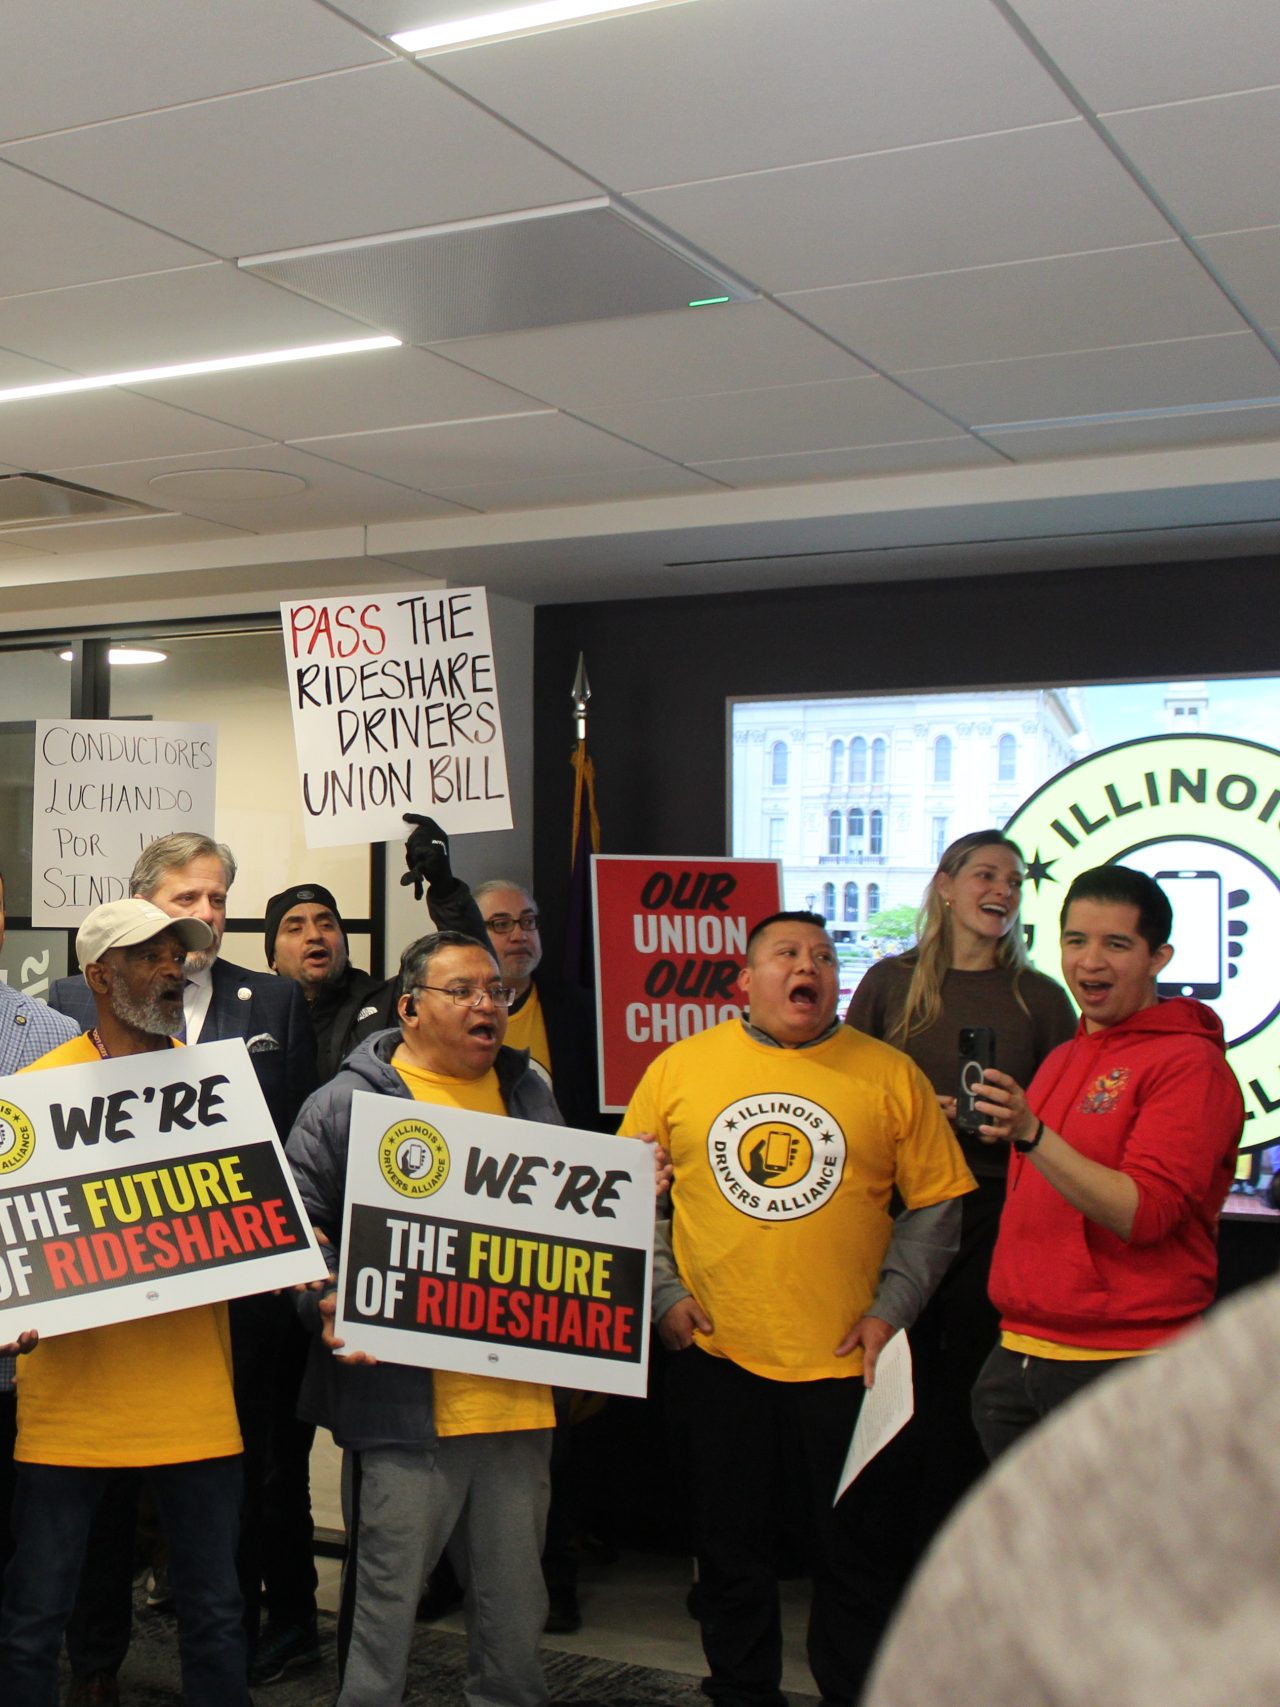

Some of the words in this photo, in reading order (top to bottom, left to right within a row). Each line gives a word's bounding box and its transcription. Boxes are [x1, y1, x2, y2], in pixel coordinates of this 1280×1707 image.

[290, 603, 386, 658] PASS
[397, 593, 474, 645] THE
[296, 652, 493, 709] RIDESHARE
[42, 727, 213, 769] CONDUCTORES
[337, 701, 496, 756] DRIVERS
[44, 779, 193, 815] LUCHANDO
[303, 758, 412, 816] UNION
[429, 754, 505, 804] BILL
[1050, 768, 1280, 848] ILLINOI
[640, 871, 737, 911] OUR
[633, 914, 747, 955] UNION
[644, 958, 741, 999] OUR
[49, 1074, 230, 1150] WE'RE
[394, 1125, 438, 1144] ILLINOIS
[738, 1102, 824, 1129] ILLINOIS
[2, 1125, 30, 1169] ALLIANCE
[384, 1149, 408, 1191] DRIVERS
[411, 1158, 446, 1193] ALLIANCE
[82, 1155, 253, 1229] FUTURE
[463, 1146, 632, 1220] WE'RE
[714, 1140, 761, 1208] DRIVERS
[766, 1155, 837, 1212] ALLIANCE
[42, 1199, 297, 1291] RIDESHARE
[385, 1218, 459, 1276] THE
[468, 1232, 614, 1299] FUTURE
[354, 1266, 406, 1319] OF
[416, 1276, 635, 1354] RIDESHARE
